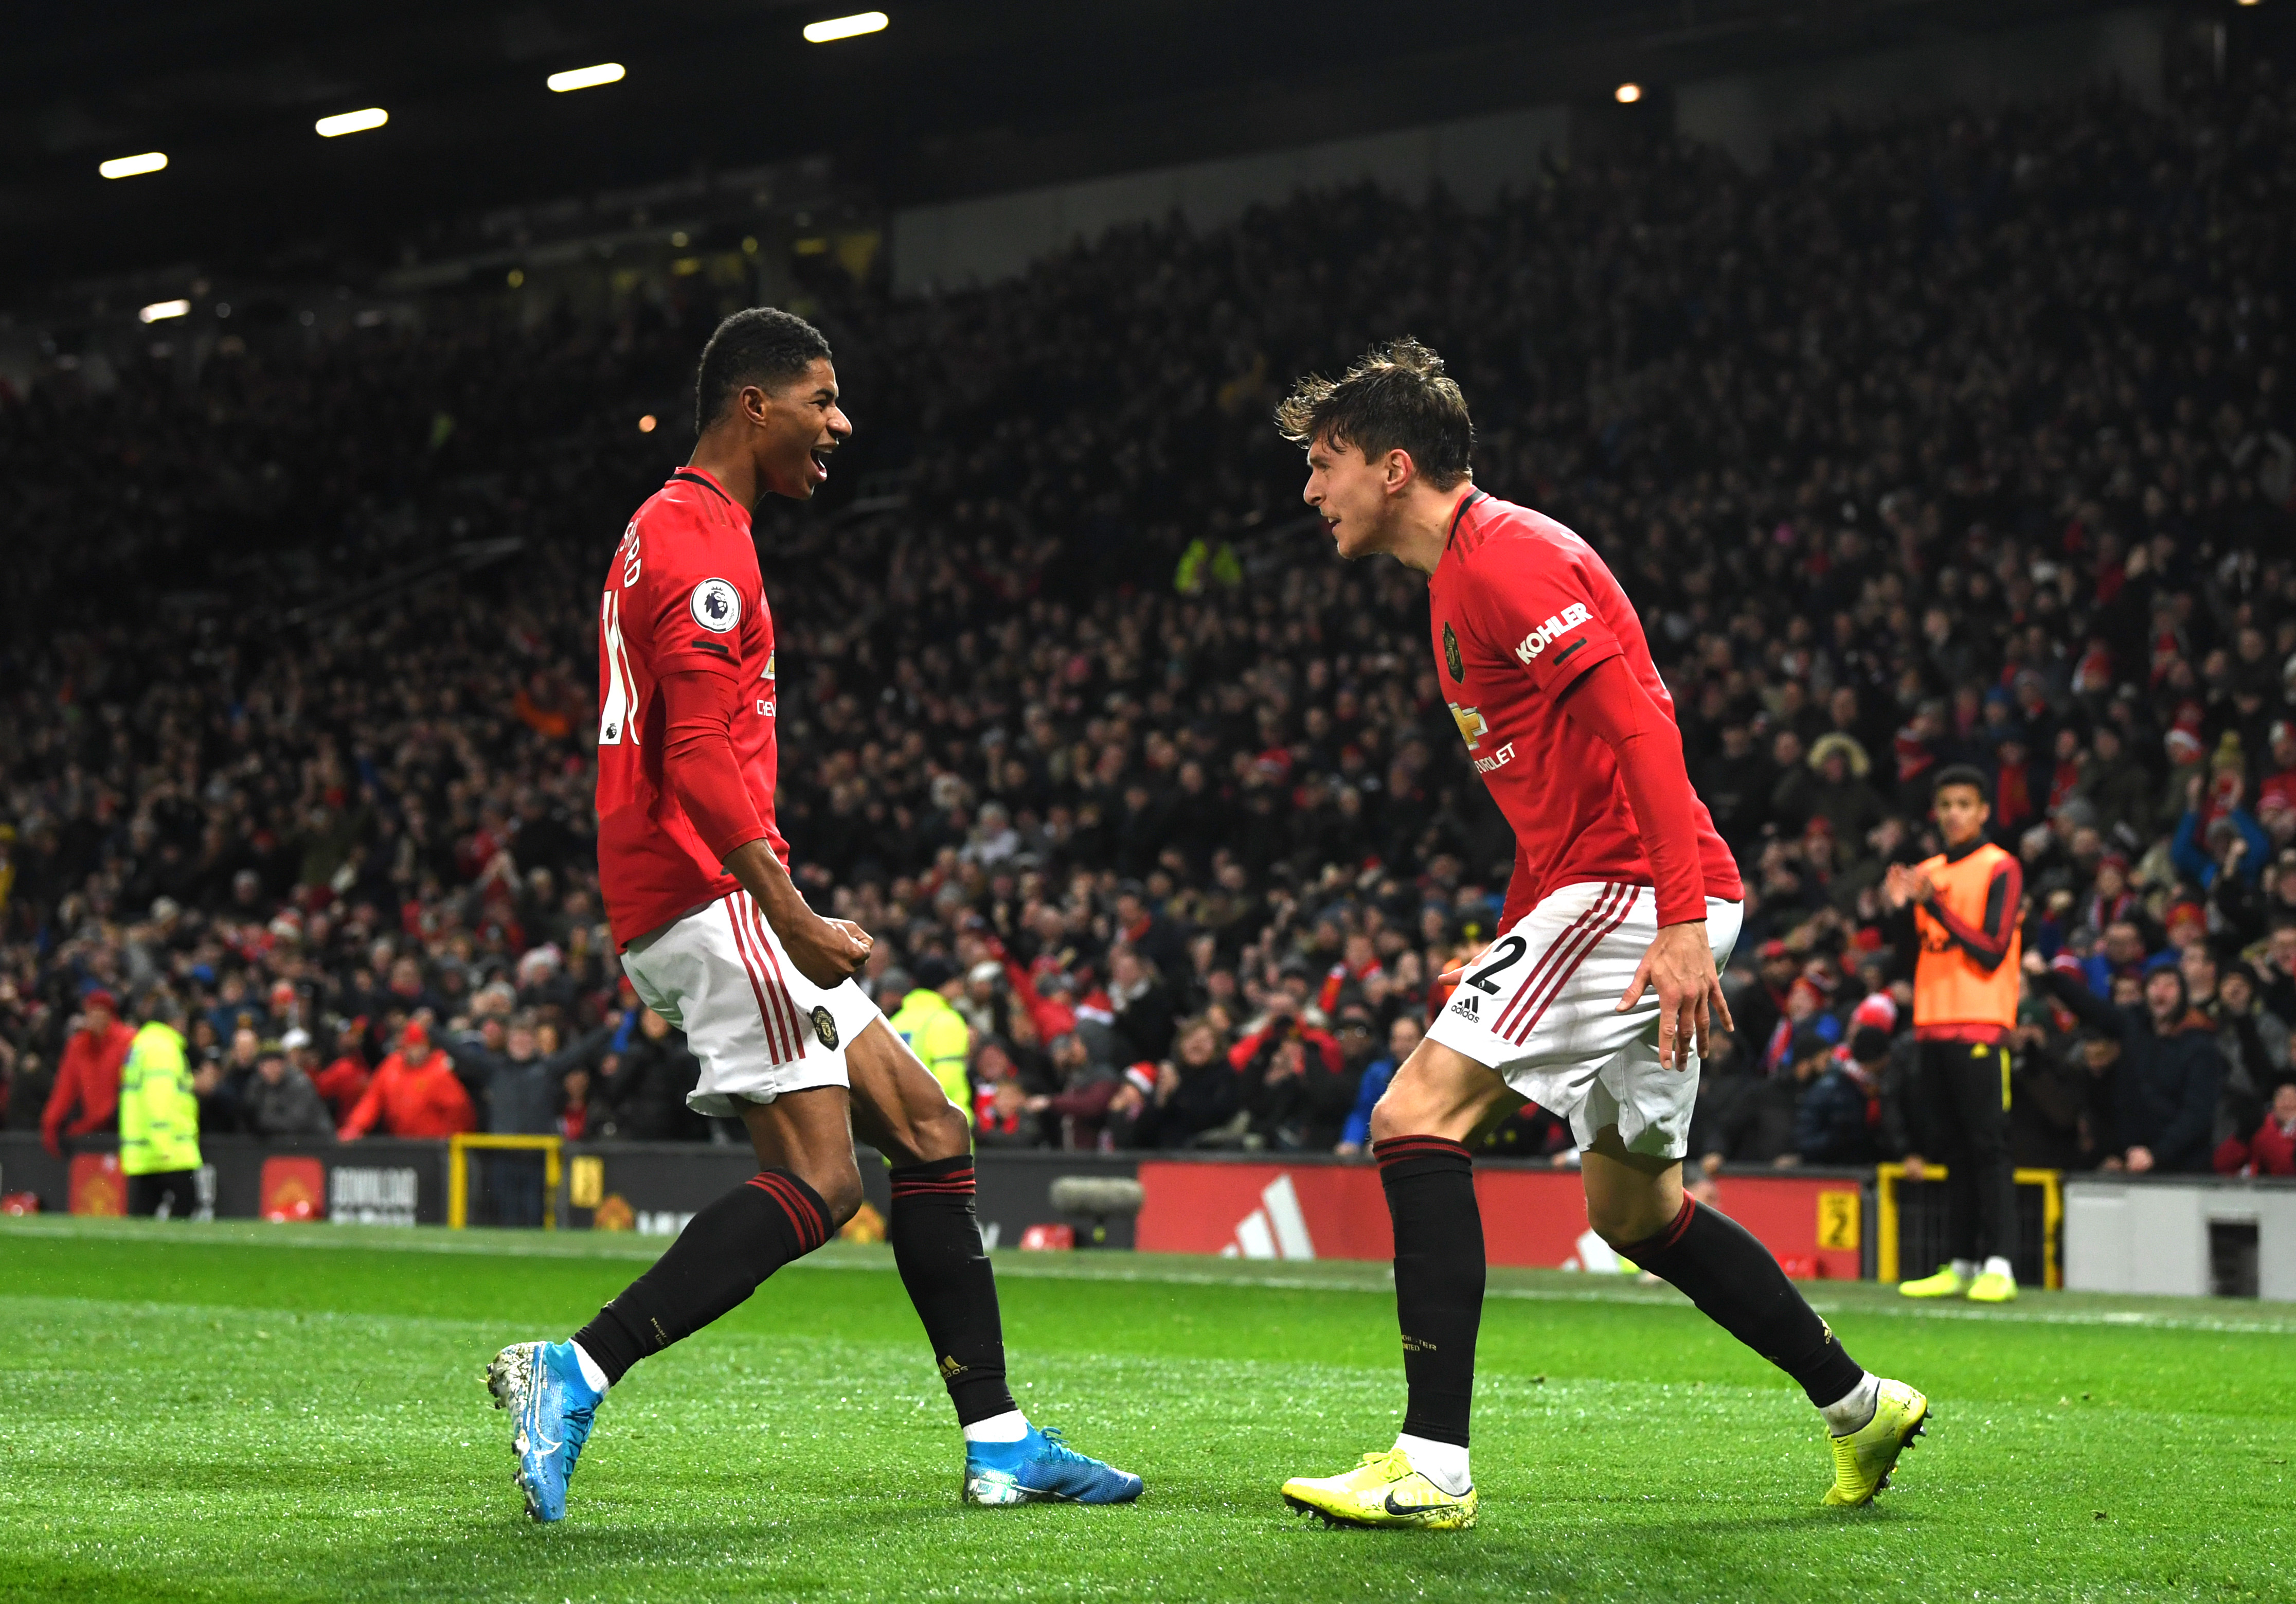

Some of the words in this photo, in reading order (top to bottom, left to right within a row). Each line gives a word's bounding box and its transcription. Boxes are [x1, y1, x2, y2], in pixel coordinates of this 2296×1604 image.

[1515, 602, 1593, 665] KOHLER
[1465, 936, 1527, 995] 2
[1451, 1005, 1480, 1023] adidas
